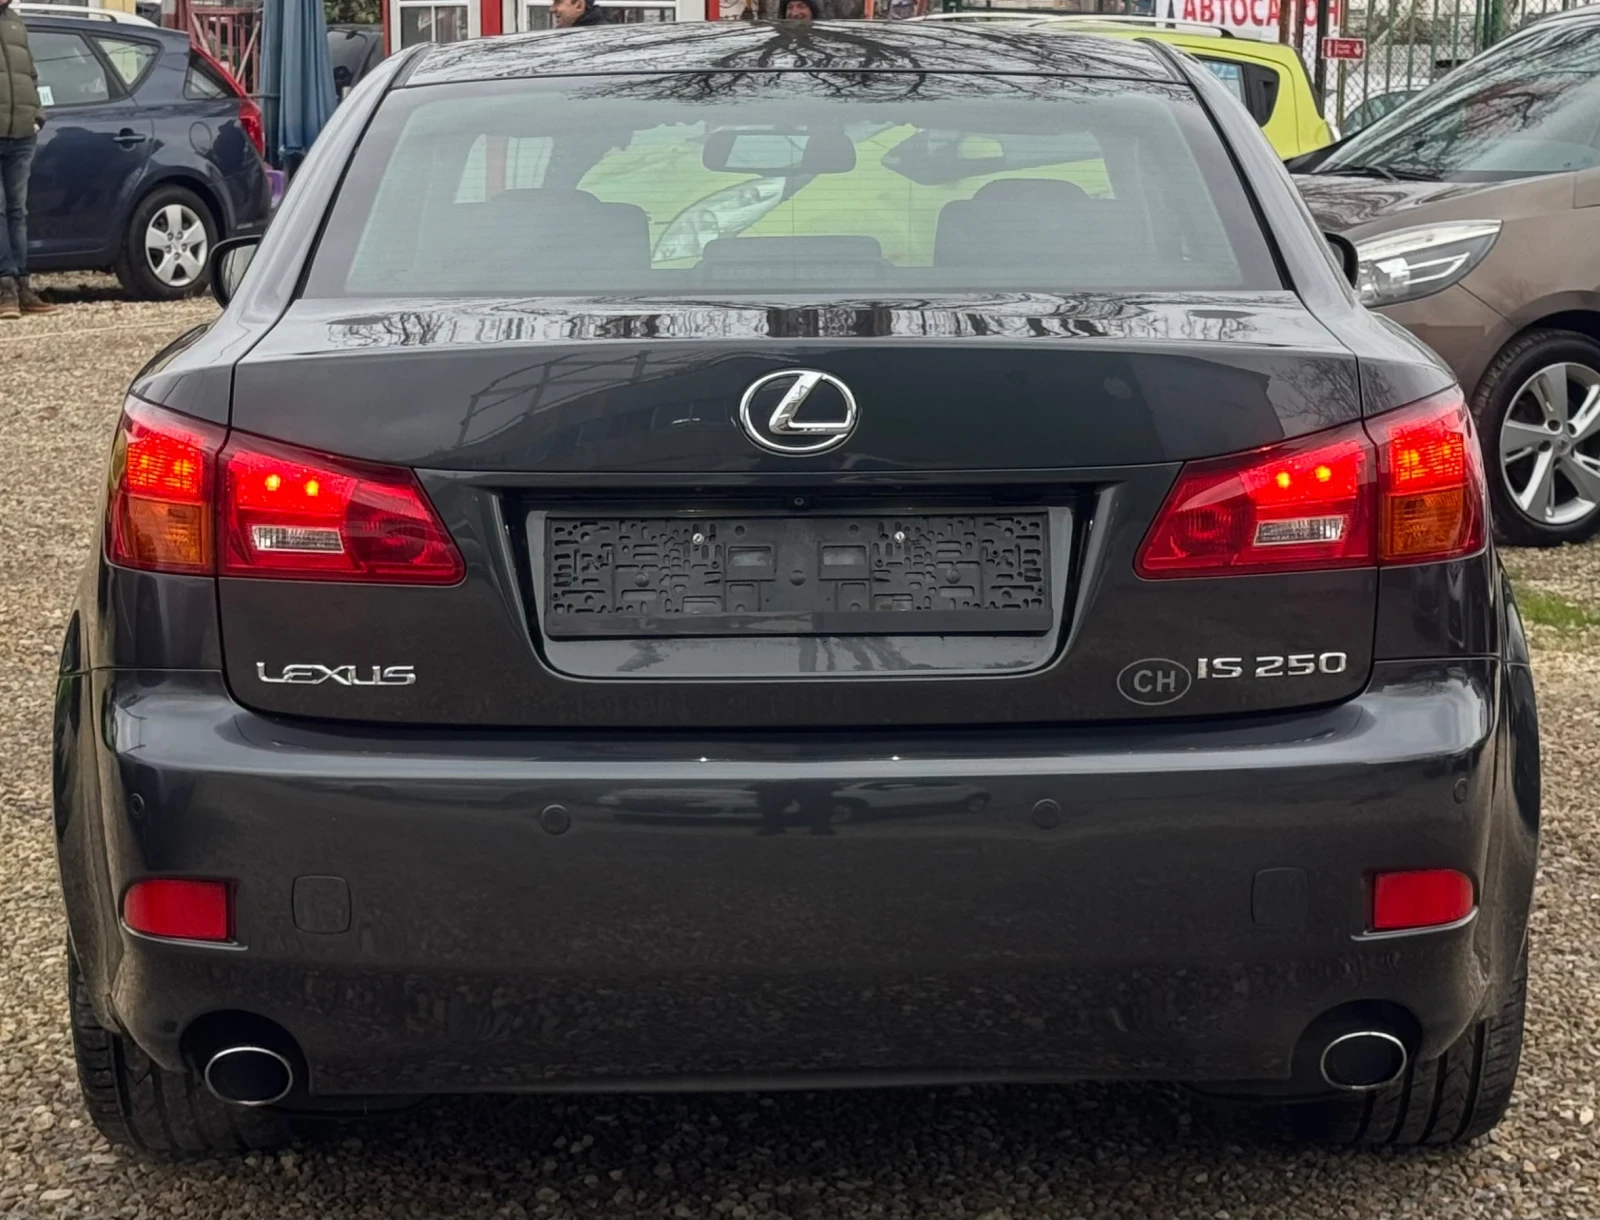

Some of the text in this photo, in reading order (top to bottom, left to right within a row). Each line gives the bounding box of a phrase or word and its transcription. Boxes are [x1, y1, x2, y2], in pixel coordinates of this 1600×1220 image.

[1182, 0, 1339, 27] АВТОСАОН
[256, 661, 417, 686] LEXUS
[1197, 652, 1348, 679] IS 250
[1133, 669, 1176, 693] CH
